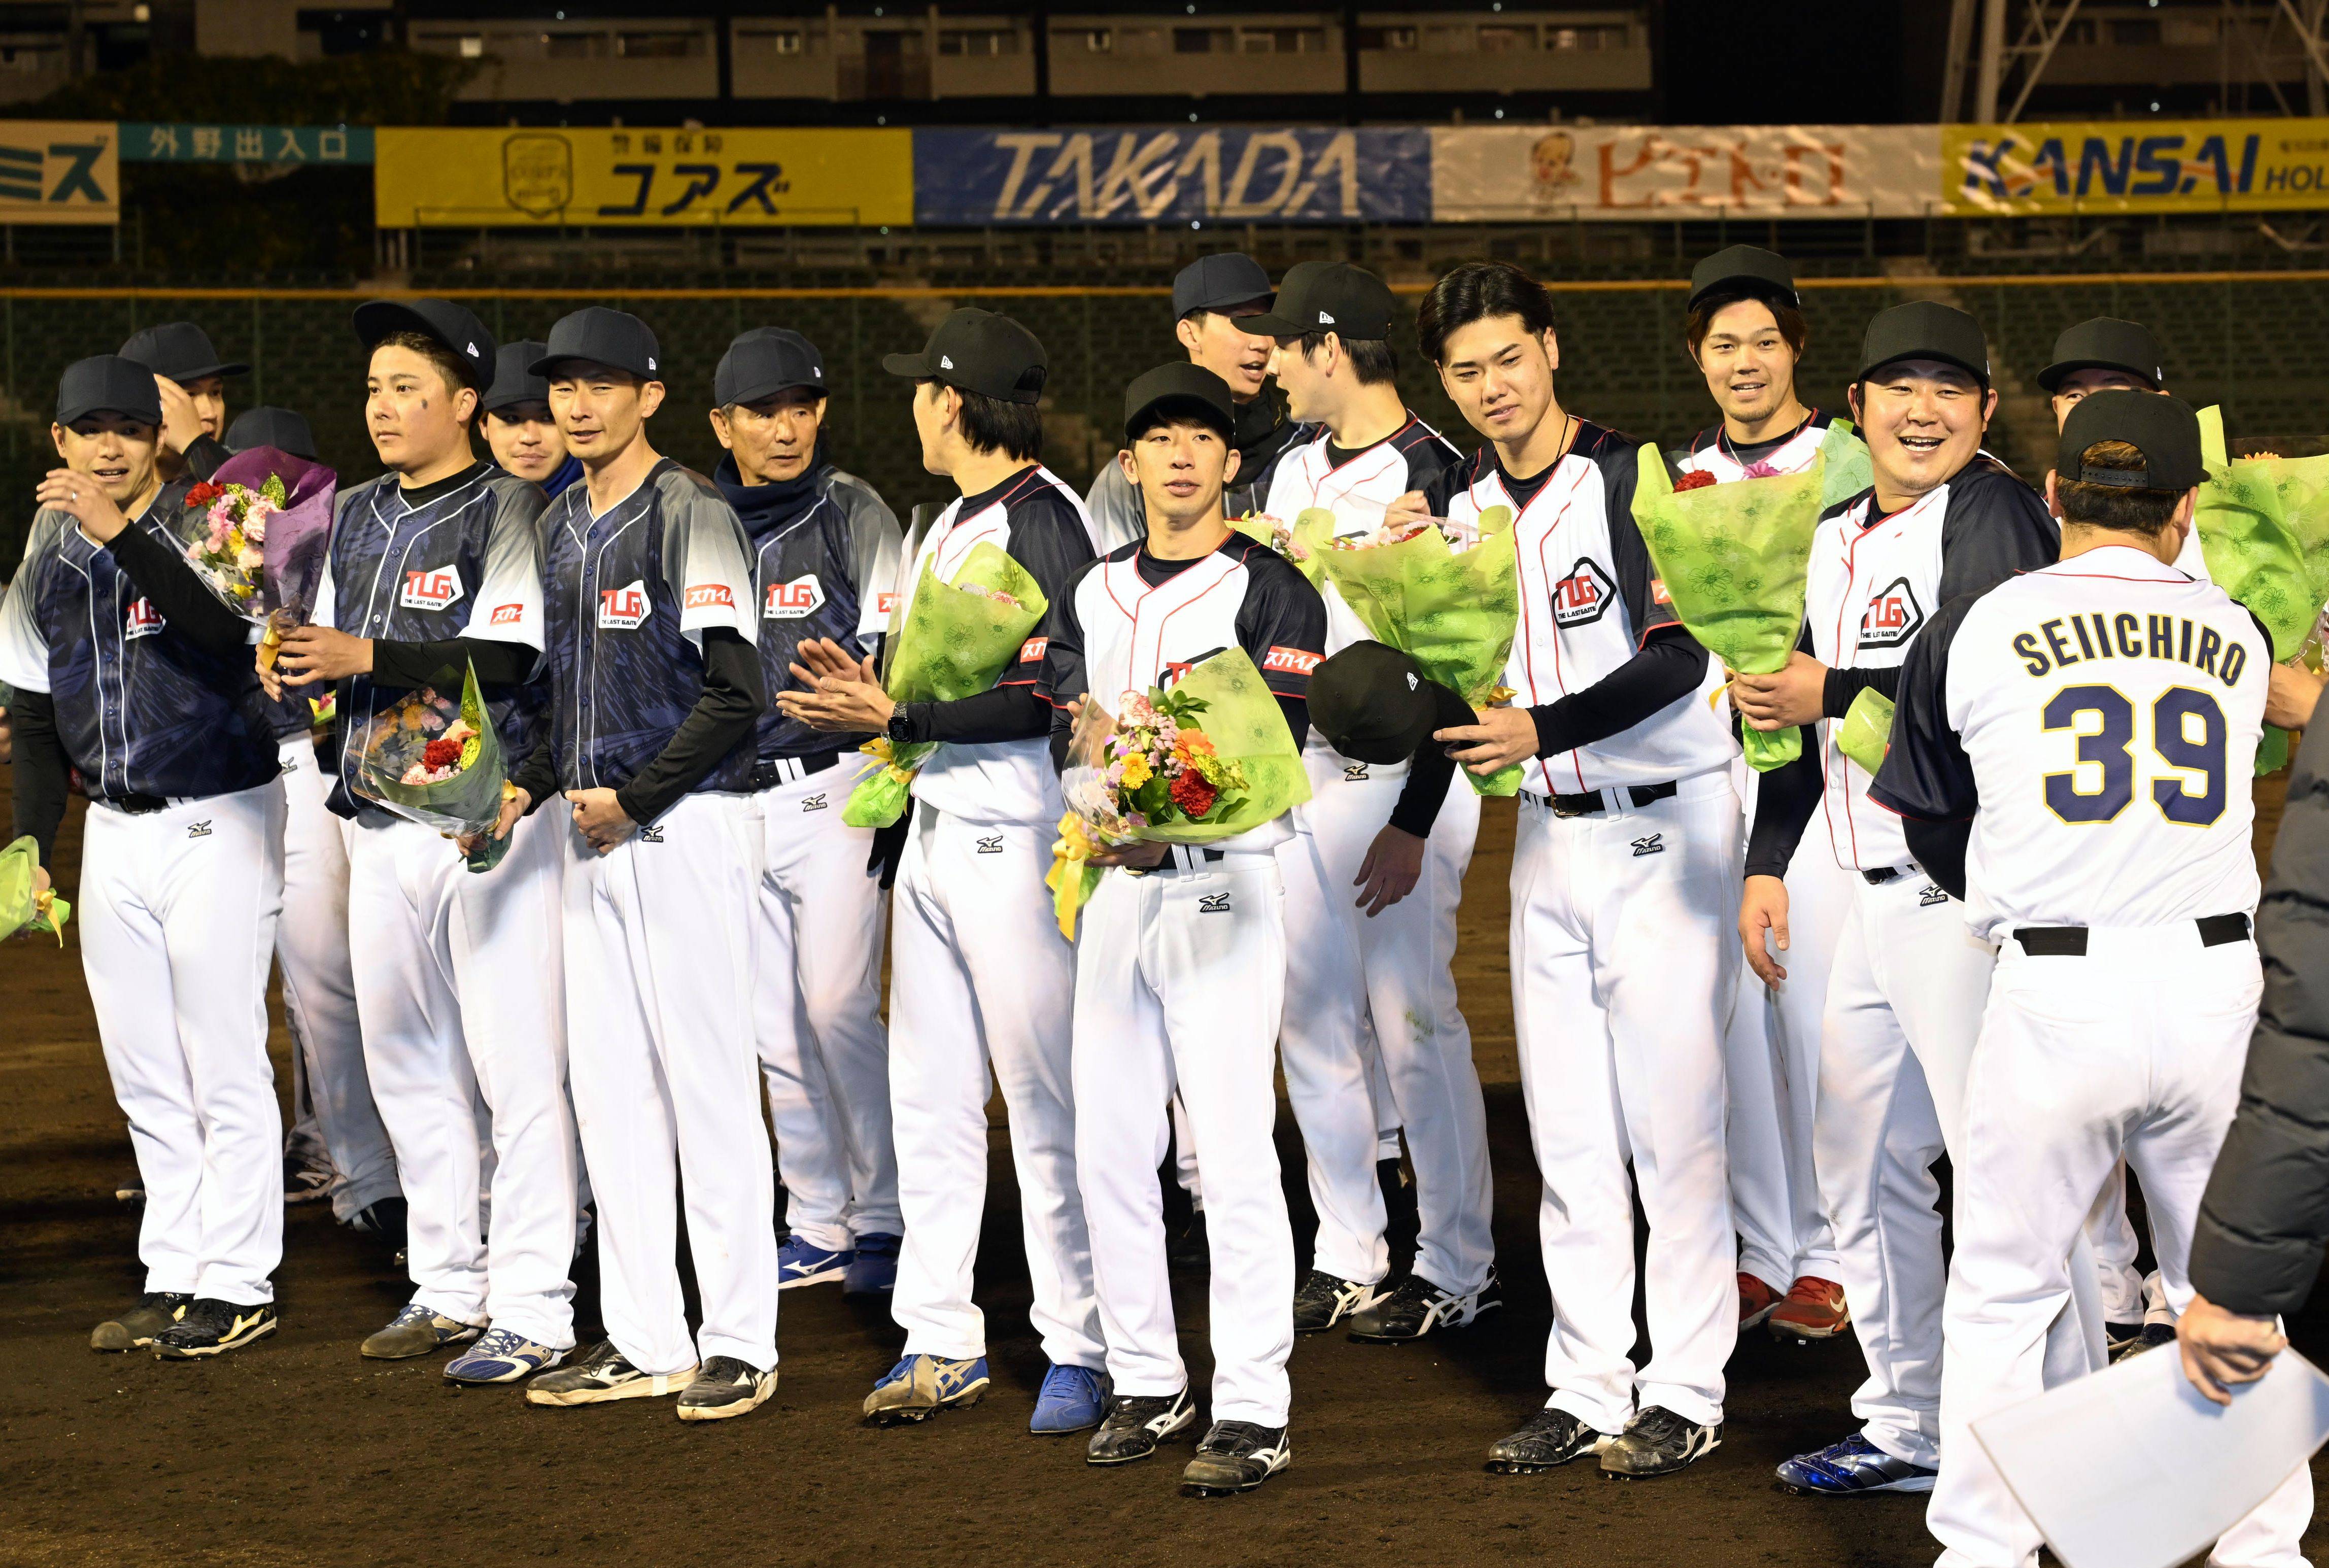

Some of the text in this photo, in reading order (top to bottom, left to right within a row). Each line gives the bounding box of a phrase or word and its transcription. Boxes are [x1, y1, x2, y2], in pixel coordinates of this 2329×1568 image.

[151, 126, 347, 159] 外野出入口
[1965, 134, 2260, 196] KANSAI
[597, 162, 790, 217] コアズ
[992, 132, 1361, 219] TAKADA
[406, 570, 451, 600] TLG
[601, 590, 641, 618] TLG
[767, 584, 811, 607] TLG
[1555, 575, 1596, 610] TLG
[2011, 612, 2247, 688] SEIICHIRO
[2041, 683, 2228, 829] 39
